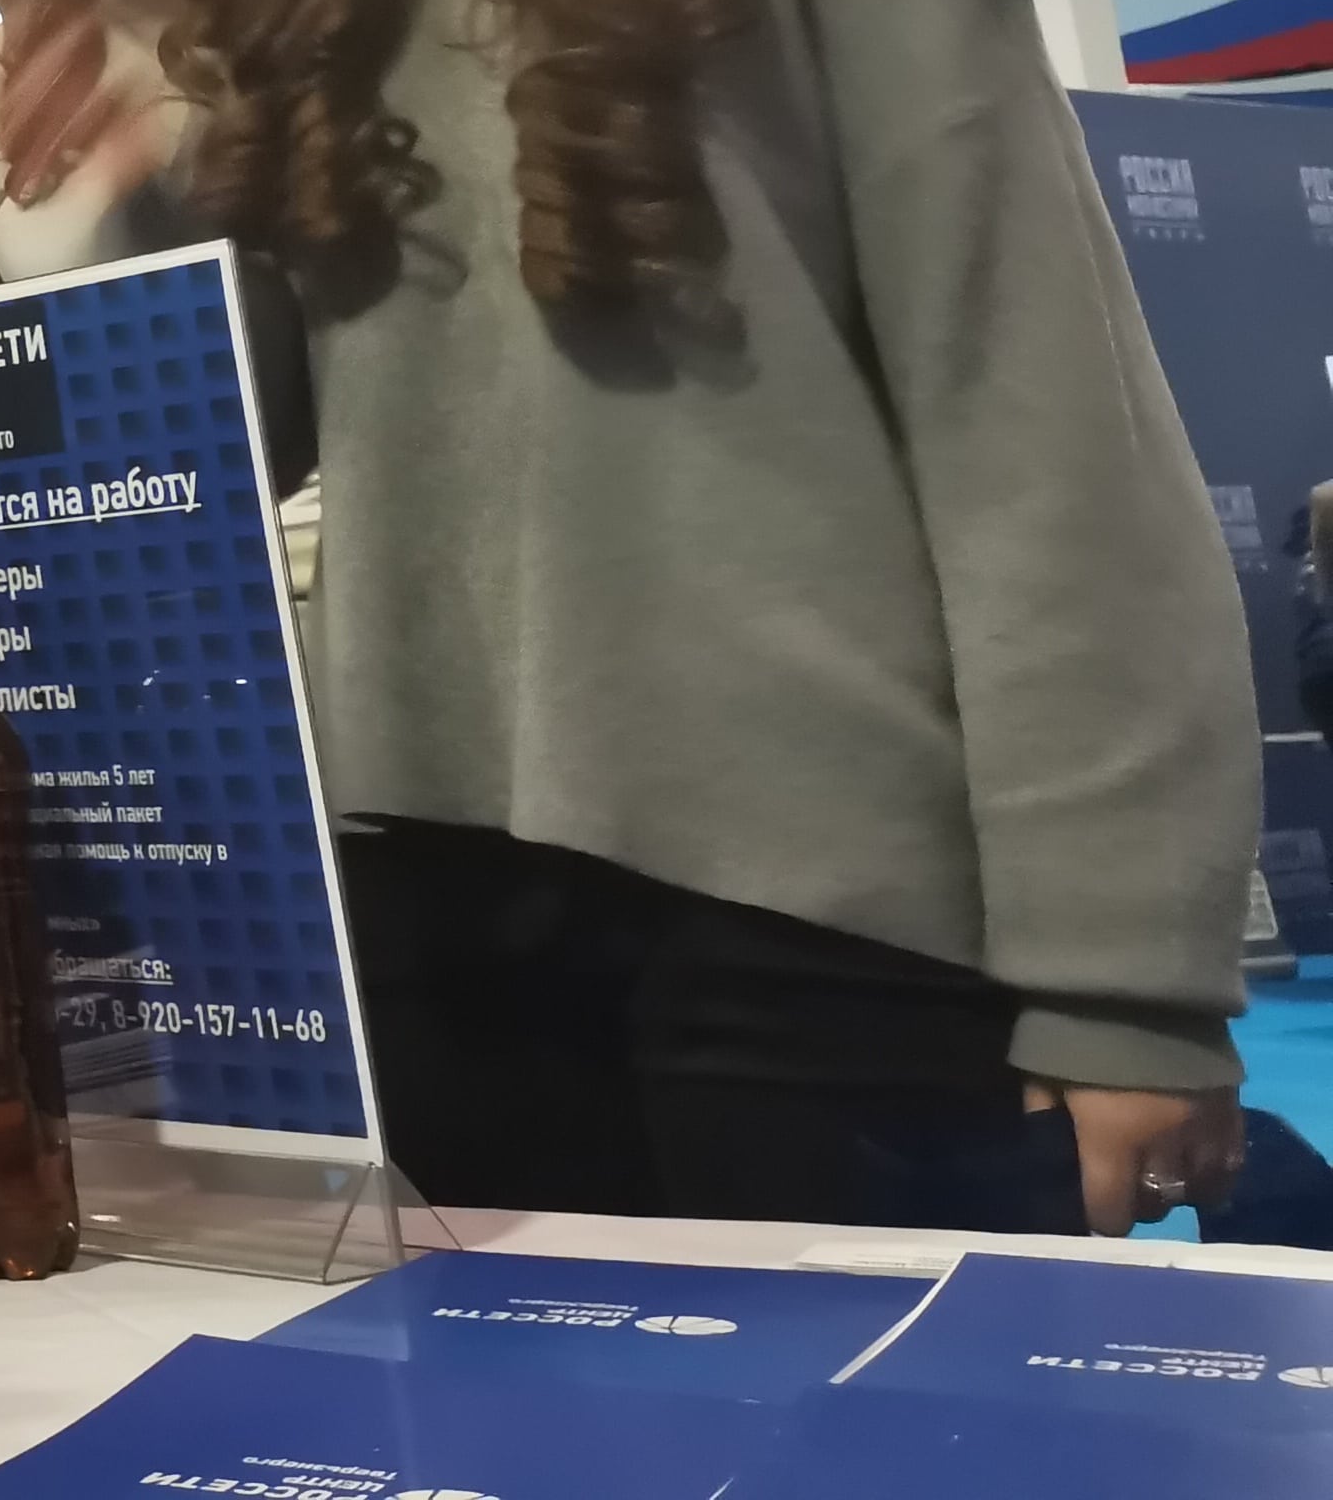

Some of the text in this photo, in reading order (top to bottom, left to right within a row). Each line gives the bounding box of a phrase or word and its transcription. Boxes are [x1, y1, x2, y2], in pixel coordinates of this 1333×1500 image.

[47, 486, 84, 518] на
[91, 466, 198, 523] работу
[57, 770, 110, 787] жилья
[112, 764, 124, 786] 5
[129, 769, 156, 786] лет
[116, 806, 163, 823] пакет
[68, 844, 131, 862] помощь
[133, 844, 144, 859] к
[148, 843, 213, 866] отпуску
[217, 844, 229, 861] в
[53, 949, 173, 981] бращаться:
[112, 999, 326, 1043] 8-920-157-11-68
[432, 1308, 623, 1327] РОССЕТИ
[1026, 1356, 1261, 1381] РОССЕТИ
[242, 1456, 398, 1481] Тверьэнерго
[282, 1475, 386, 1493] ЦЕНТР
